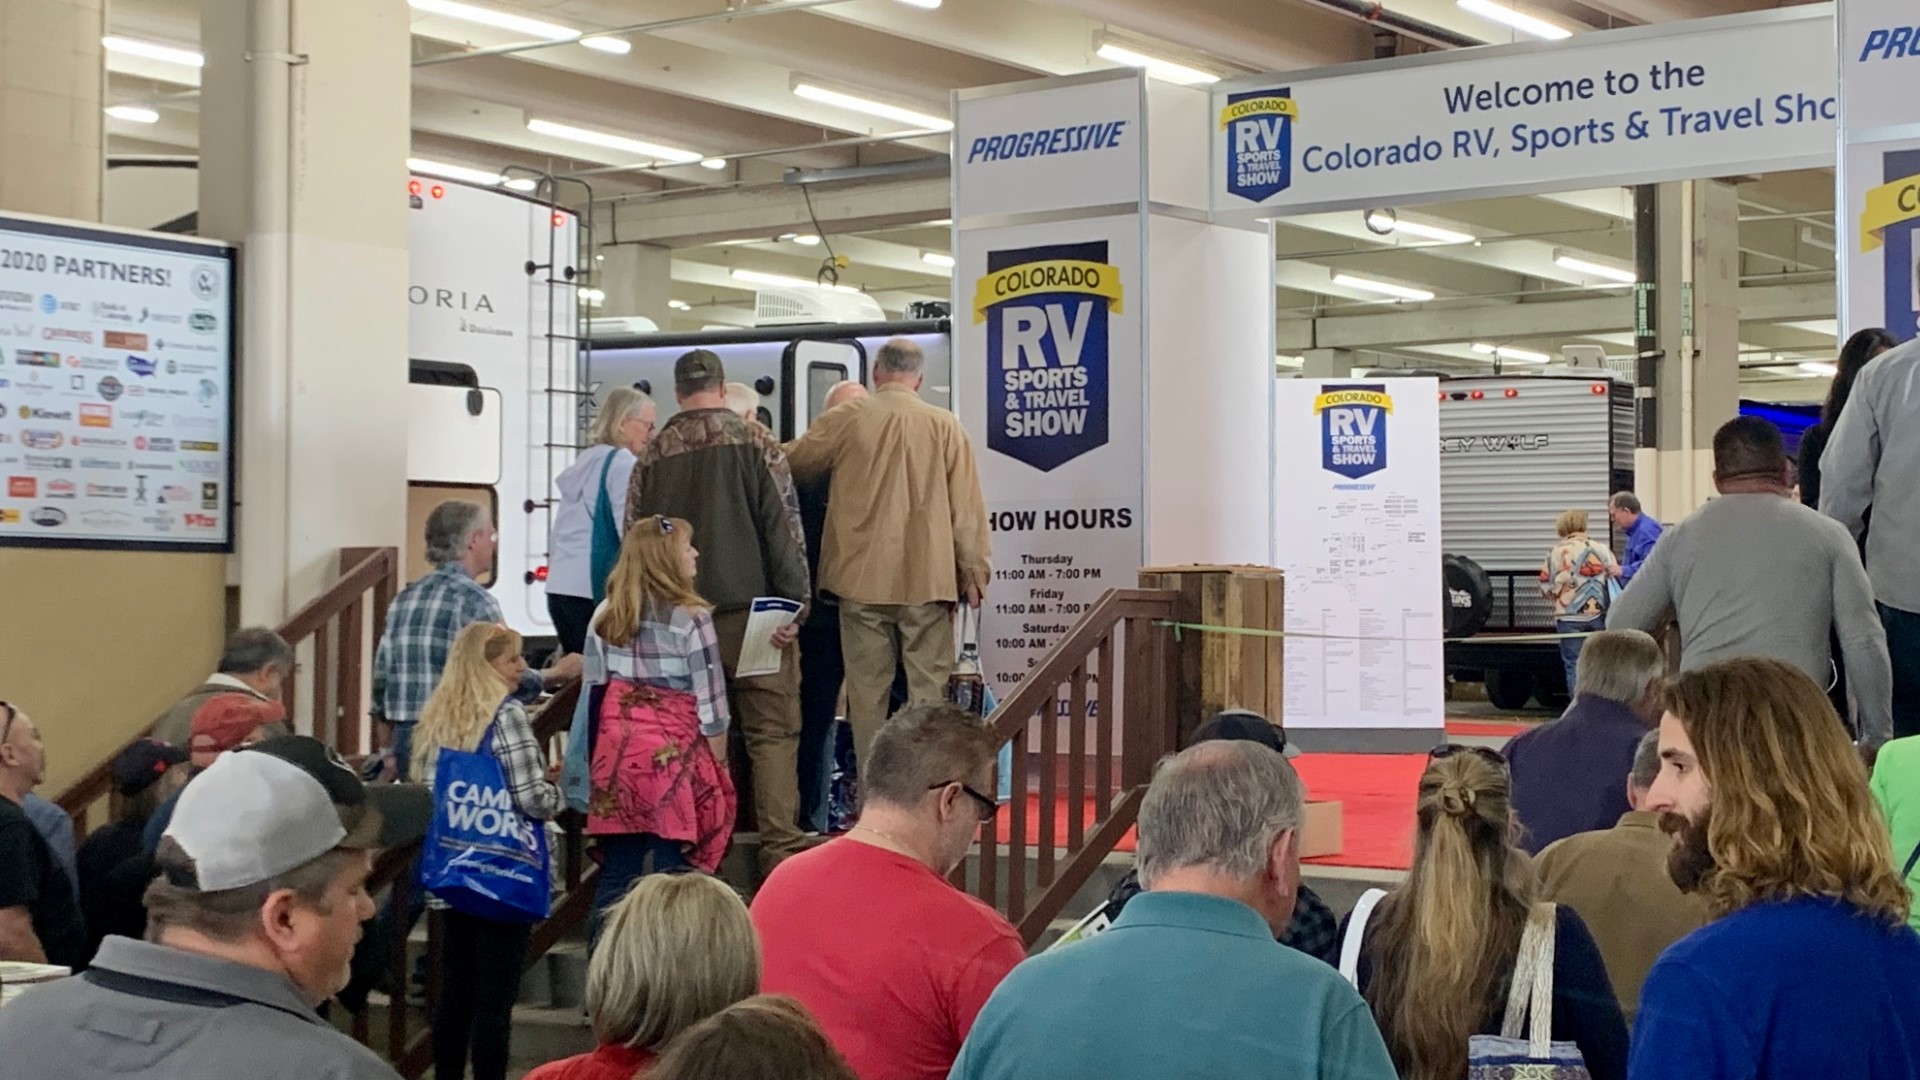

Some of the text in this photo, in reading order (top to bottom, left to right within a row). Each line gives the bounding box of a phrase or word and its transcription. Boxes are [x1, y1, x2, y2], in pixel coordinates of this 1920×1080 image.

[1444, 61, 1705, 114] Welcome to the
[1231, 101, 1287, 117] COLORADO
[967, 120, 1126, 164] PROGRESSIVE
[1236, 117, 1284, 153] RV
[1303, 93, 1836, 172] Colorado RV, Sports & Travel Sho
[1237, 150, 1281, 164] SPORTS
[1237, 161, 1282, 173] & TRAVEL
[1237, 170, 1280, 187] SHOW
[1, 250, 172, 287] 2020 PARTNERS!
[995, 266, 1100, 296] COLORADO
[408, 285, 495, 313] ORIA
[1002, 301, 1093, 370] RV
[1005, 367, 1088, 391] SPORTS
[1005, 389, 1090, 410] & TRAVEL
[1326, 393, 1382, 404] COLORADO
[1006, 409, 1087, 437] SHOW
[1330, 408, 1378, 436] RV
[1331, 435, 1376, 445] SPORTS
[1332, 444, 1377, 453] & TRAVEL
[1332, 453, 1376, 465] SHOW
[989, 508, 1132, 532] HOW HOURS
[1021, 554, 1073, 566] Thursday
[995, 569, 1025, 580] 11:00
[1028, 569, 1046, 579] AM
[1056, 568, 1080, 579] 7:00
[1083, 568, 1101, 578] PM
[1030, 588, 1064, 600] Friday
[995, 604, 1025, 614] 11:00
[1028, 604, 1046, 614] AM
[1056, 603, 1080, 614] 7:00
[995, 638, 1025, 649] 10:00
[1028, 638, 1046, 648] AM
